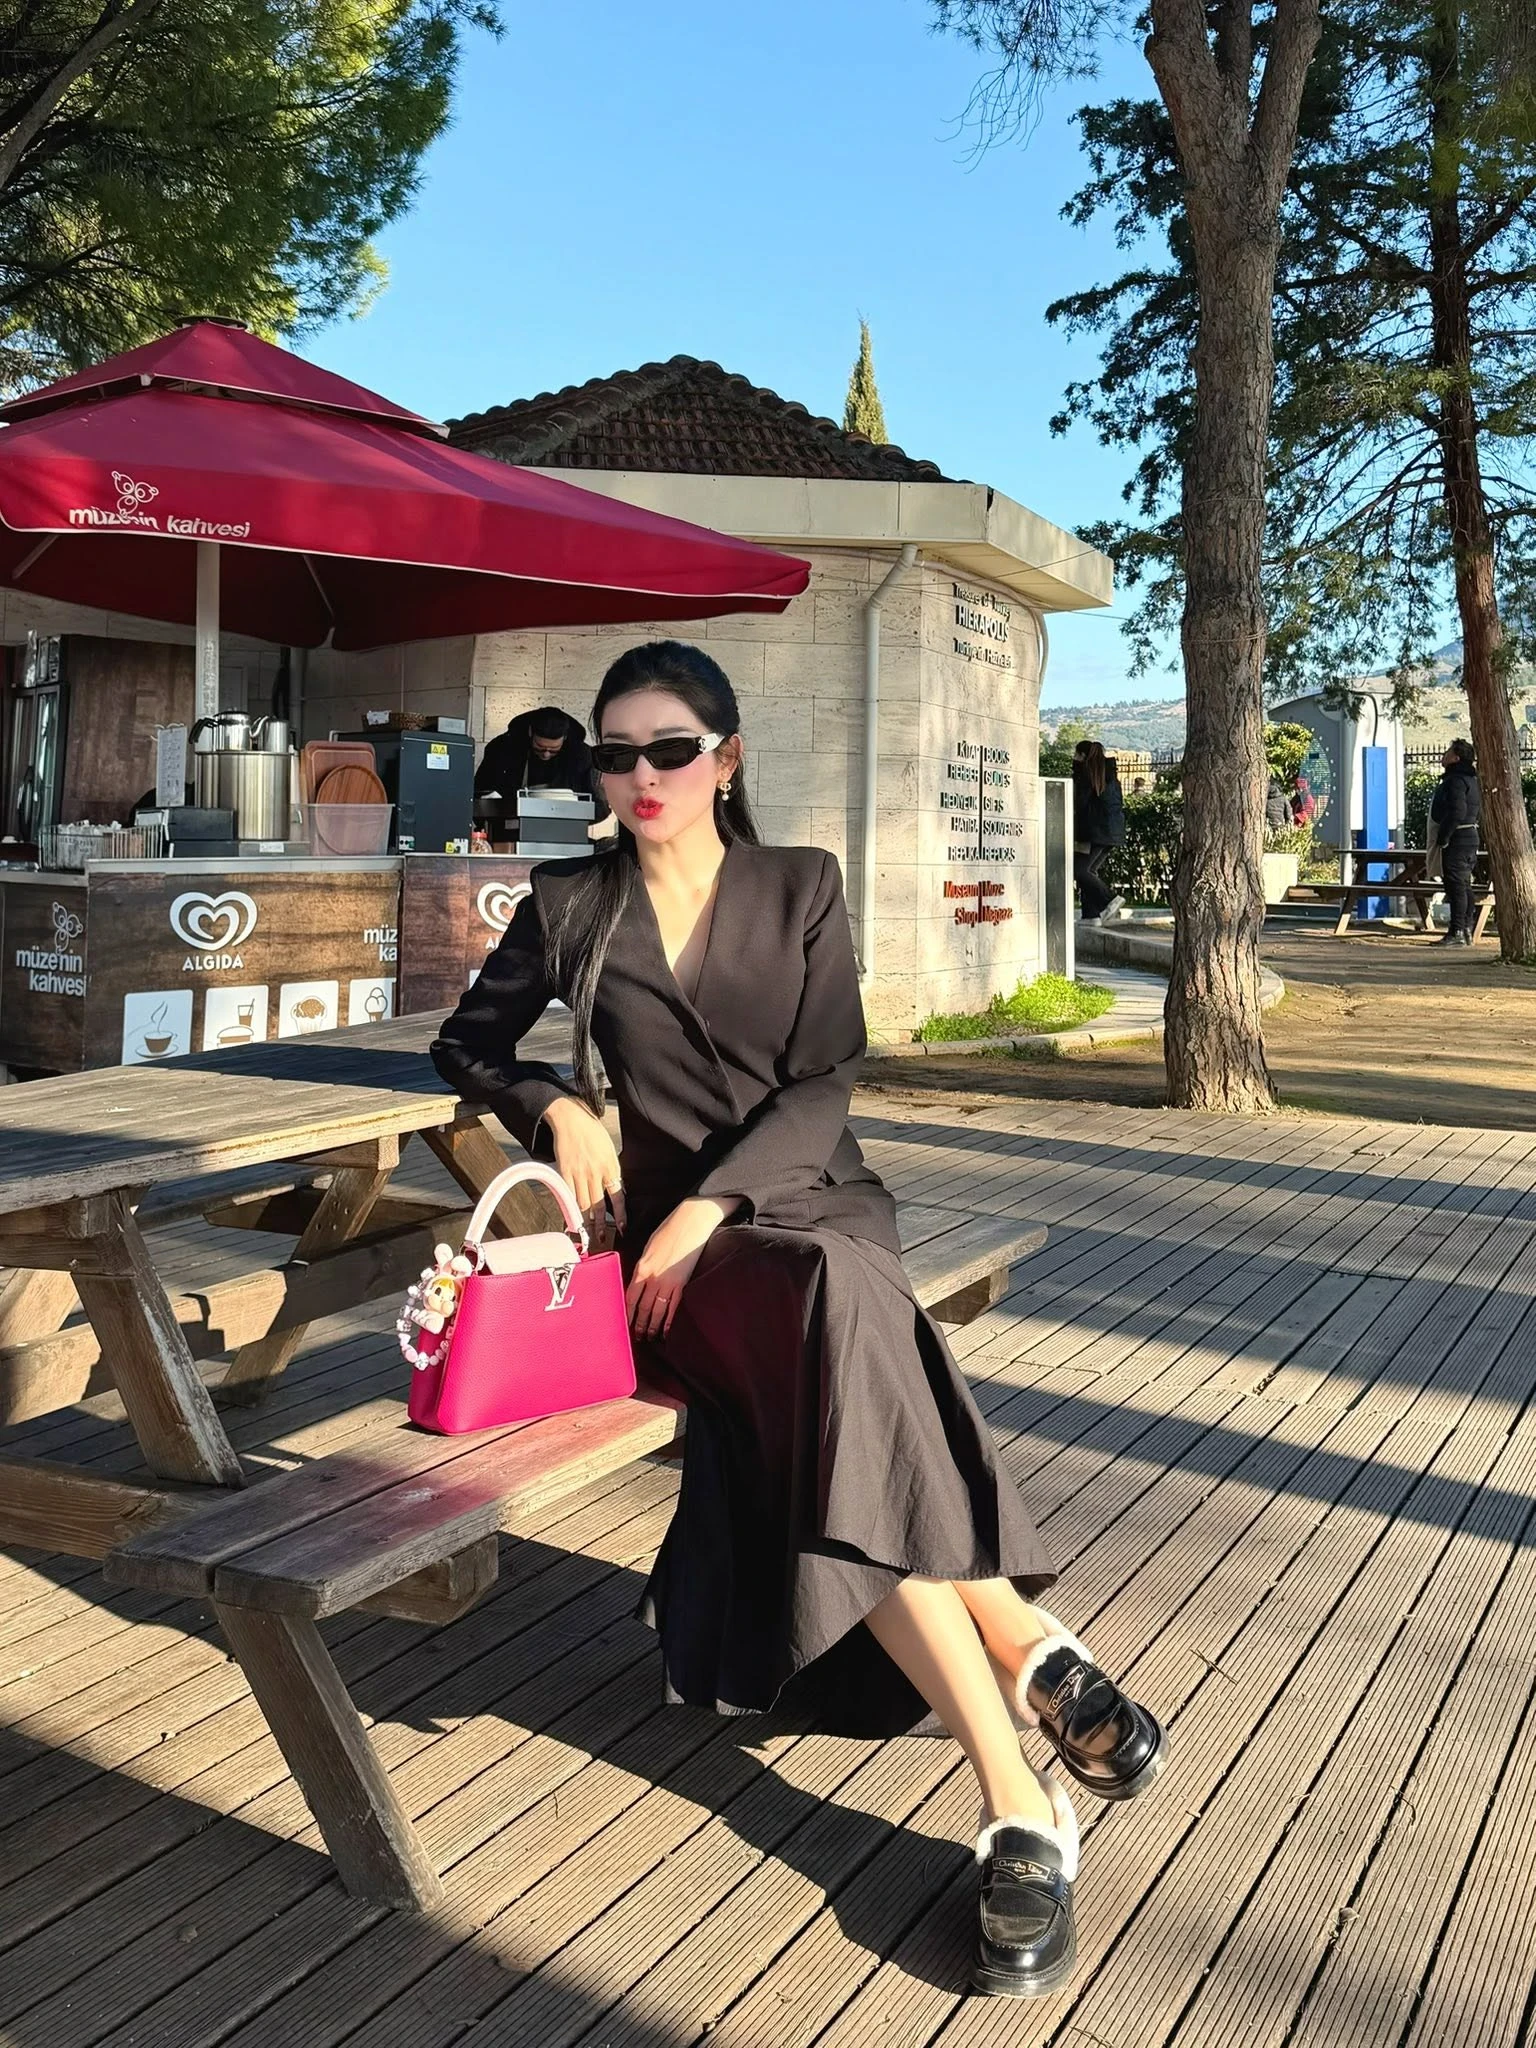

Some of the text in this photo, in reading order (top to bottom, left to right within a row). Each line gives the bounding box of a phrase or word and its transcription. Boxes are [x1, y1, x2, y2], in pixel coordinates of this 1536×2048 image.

[167, 515, 250, 538] kahvesi
[956, 604, 1010, 643] HIERAPOLIS
[983, 747, 1010, 764] BOOKS
[947, 763, 979, 782] REHBER
[943, 880, 979, 899] Museum
[954, 906, 979, 928] Shop
[182, 954, 244, 972] ALGIDA
